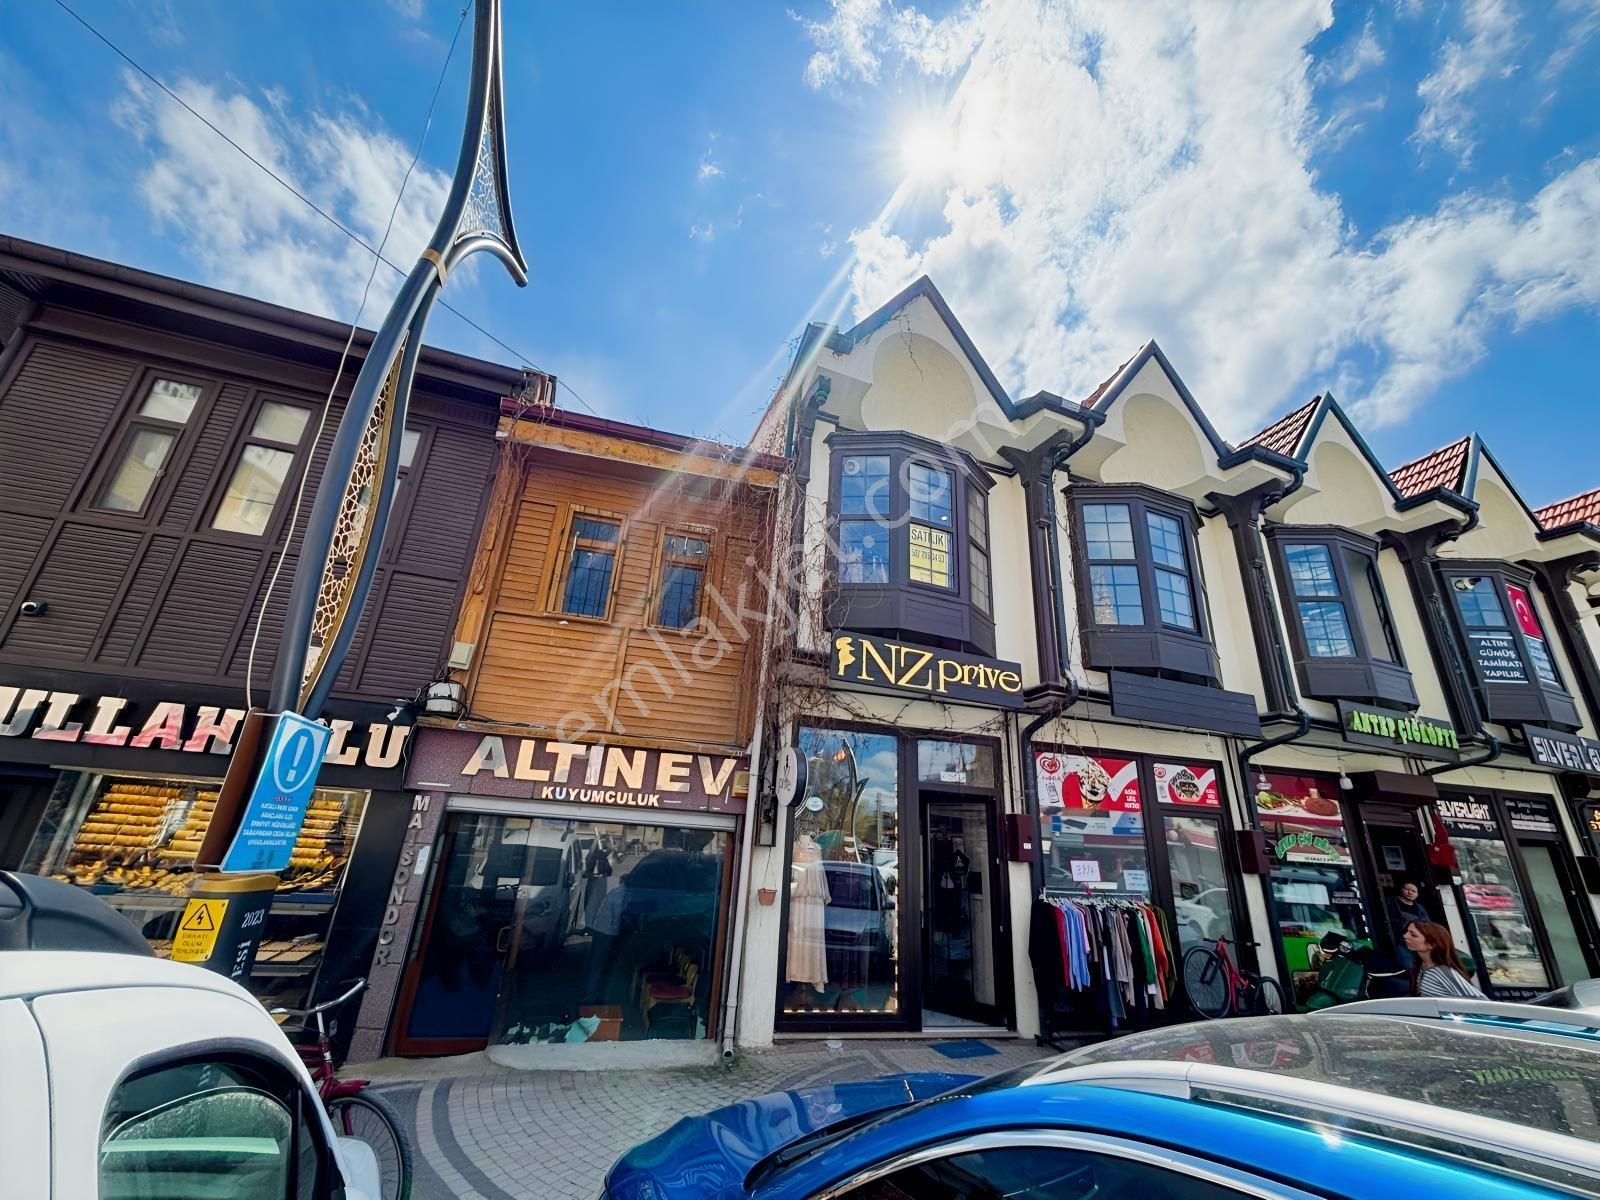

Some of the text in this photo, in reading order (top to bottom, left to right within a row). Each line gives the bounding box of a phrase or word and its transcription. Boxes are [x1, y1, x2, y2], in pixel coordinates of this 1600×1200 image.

[911, 528, 944, 547] SATIK
[461, 735, 737, 796] ALTINEV
[541, 785, 660, 807] KUYUMCULUK
[241, 909, 265, 929] 2023
